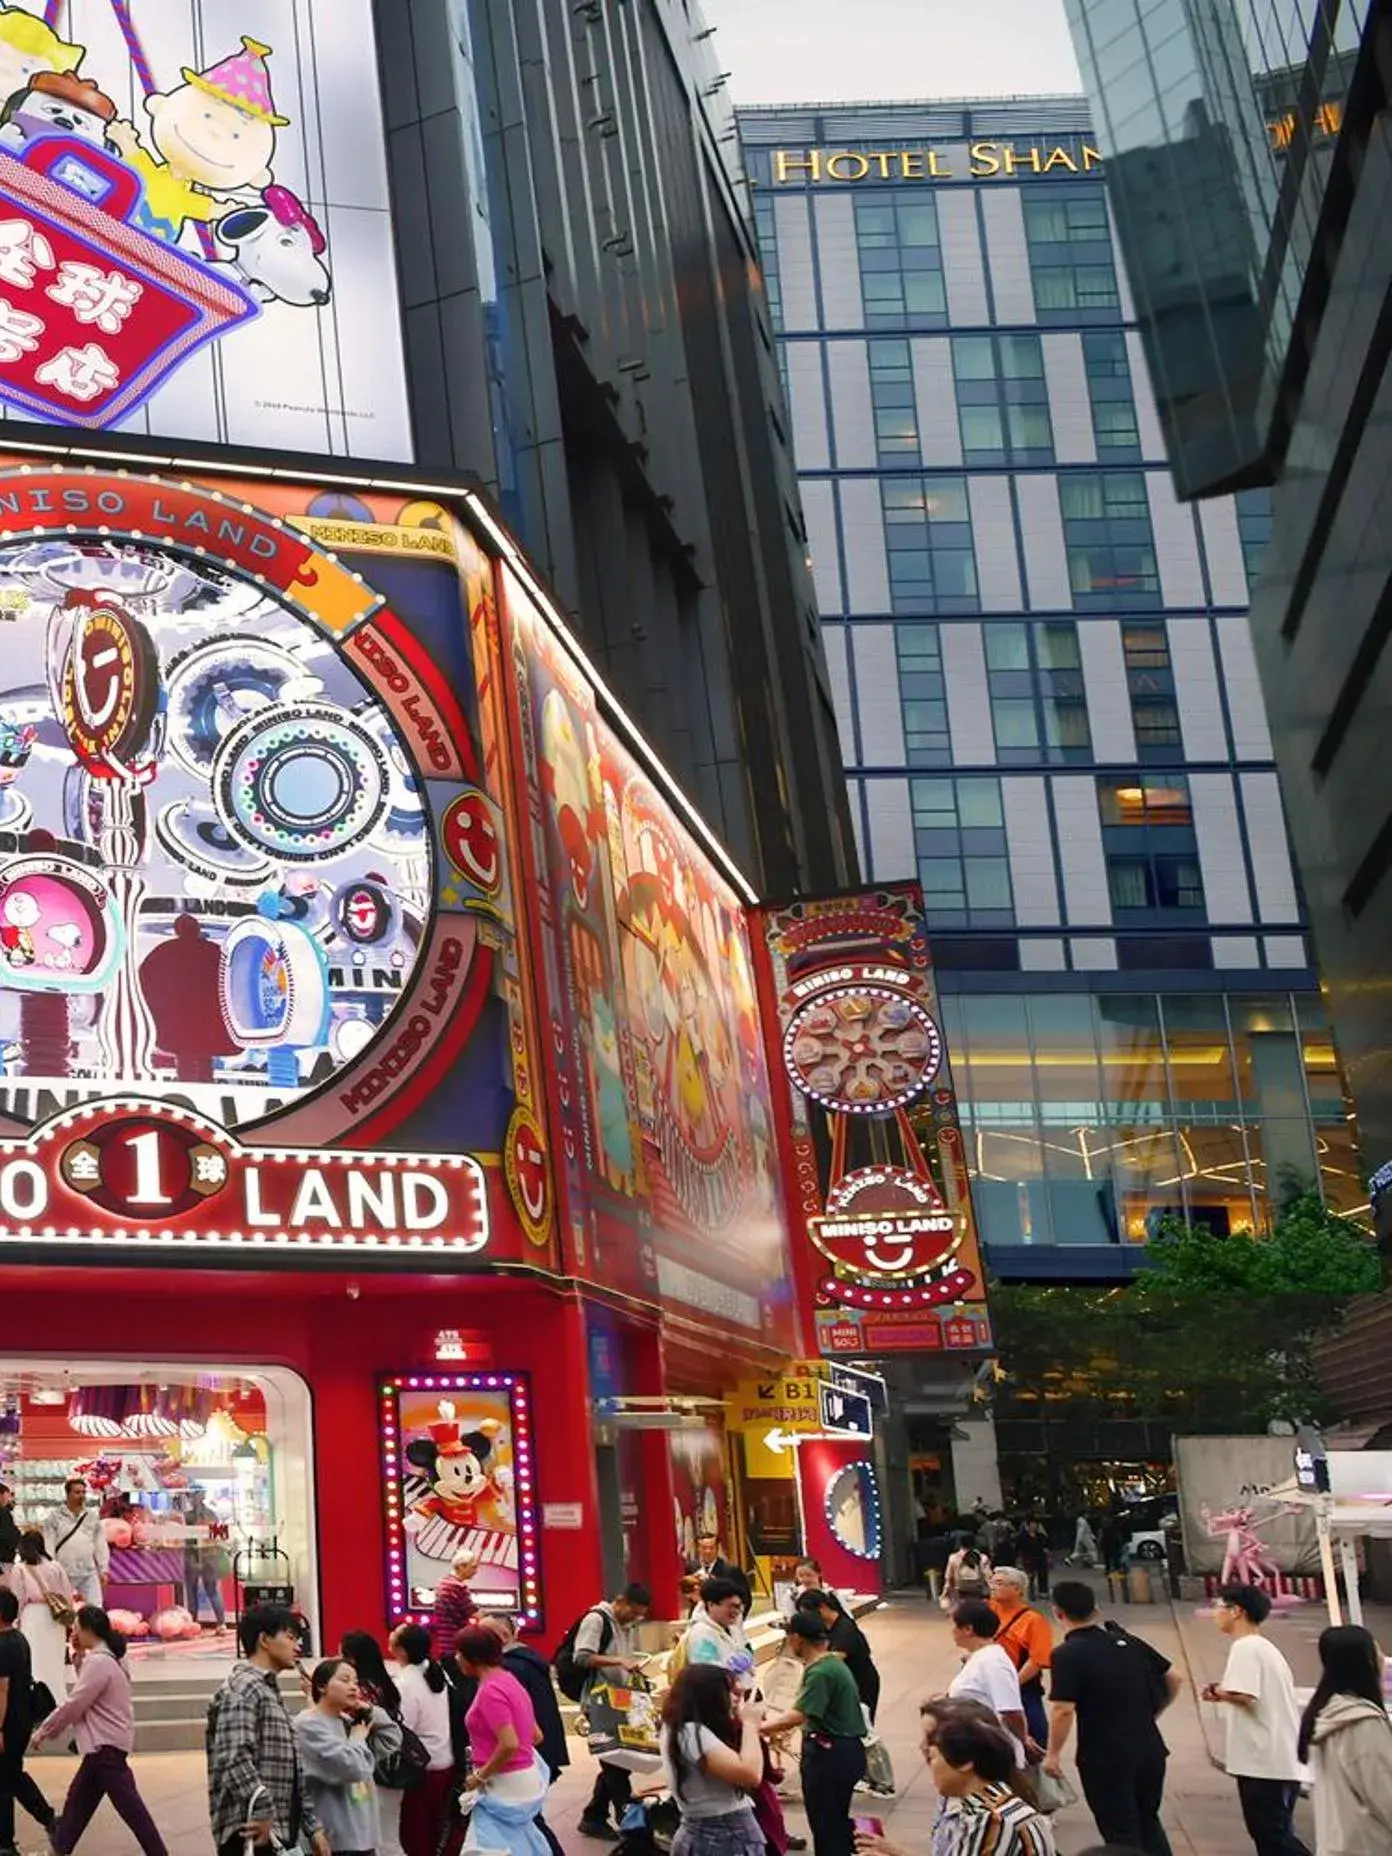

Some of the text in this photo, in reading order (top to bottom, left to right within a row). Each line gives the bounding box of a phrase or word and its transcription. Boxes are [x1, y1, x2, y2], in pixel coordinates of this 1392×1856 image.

[774, 148, 952, 184] HOTEL
[151, 496, 279, 560] LAND
[310, 524, 398, 548] MINISO
[403, 694, 452, 771] LAND
[338, 935, 464, 1116] MINISO LAND
[68, 1153, 100, 1182] 全
[124, 1130, 173, 1205] 1
[195, 1155, 225, 1184] 球
[246, 1166, 450, 1230] LAND
[820, 1217, 954, 1238] MINISO LAND
[785, 1383, 815, 1400] B1
